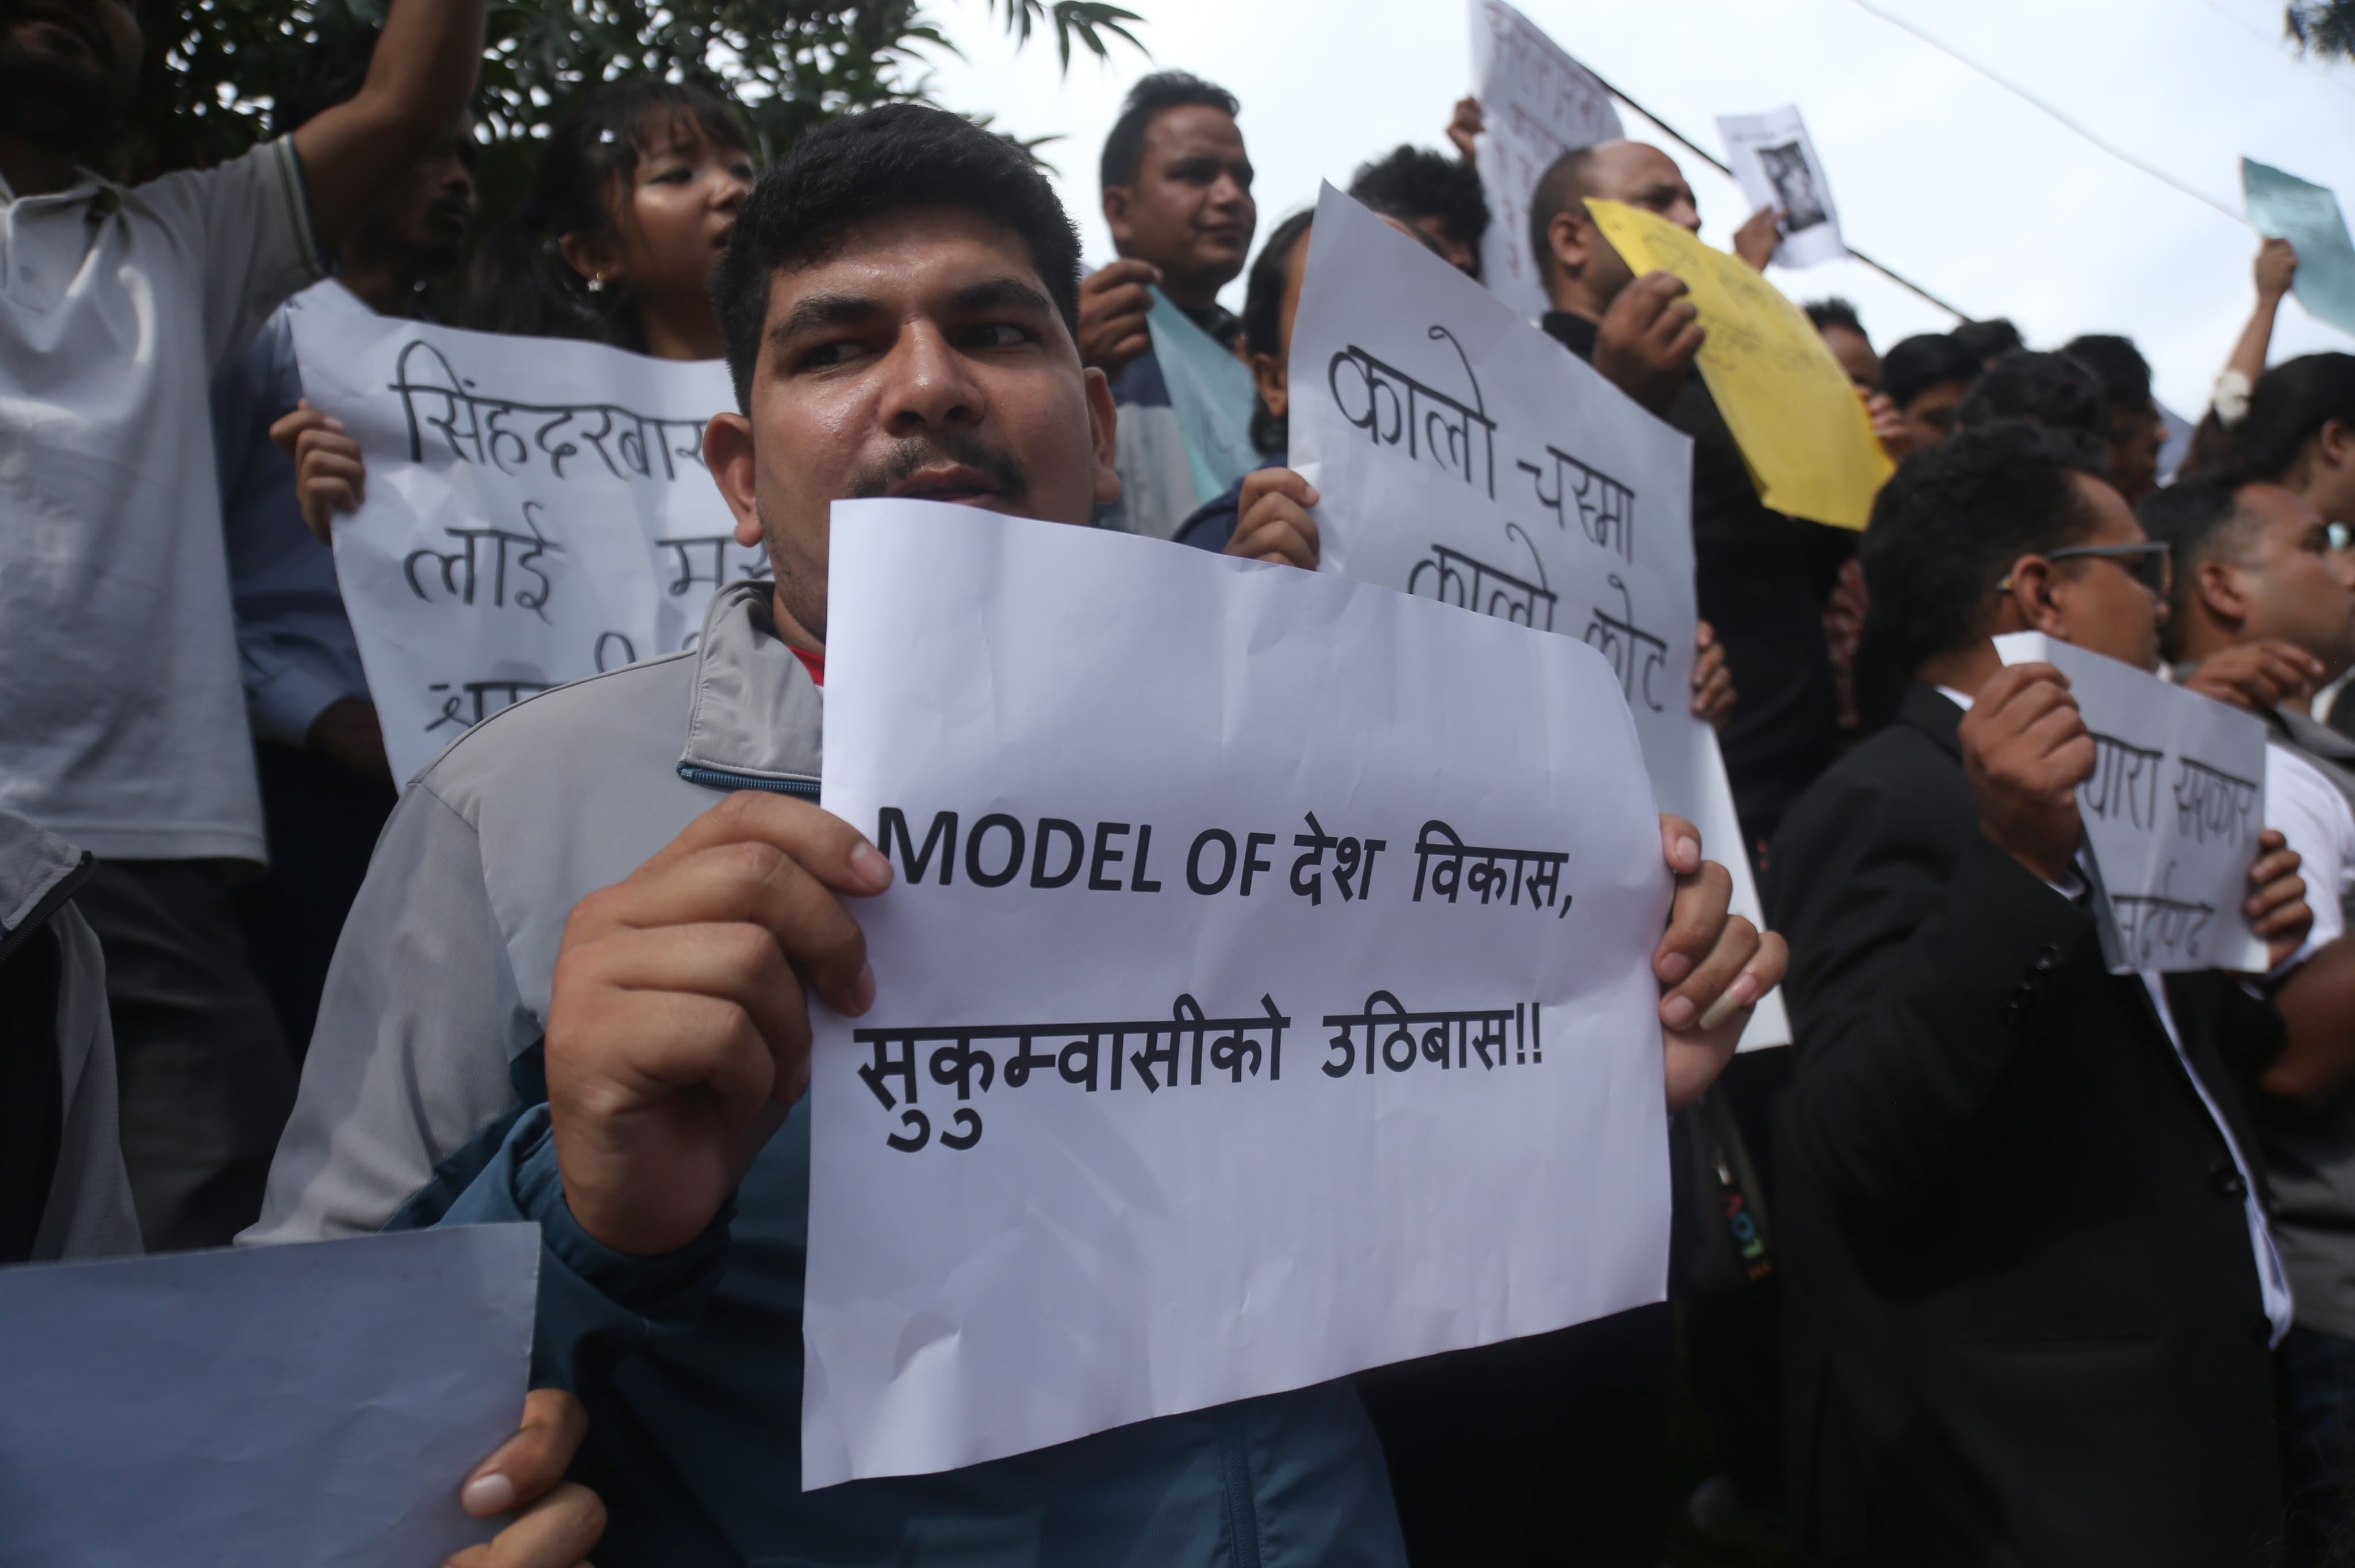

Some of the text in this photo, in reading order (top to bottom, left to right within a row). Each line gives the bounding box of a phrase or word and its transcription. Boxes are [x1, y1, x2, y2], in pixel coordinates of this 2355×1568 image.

[1328, 325, 1498, 502] कालो
[403, 501, 564, 625] लाई
[877, 806, 1573, 920] MODEL OF देश विकास,
[853, 990, 1543, 1153] सुकुम्वासीको उठिबास!!
